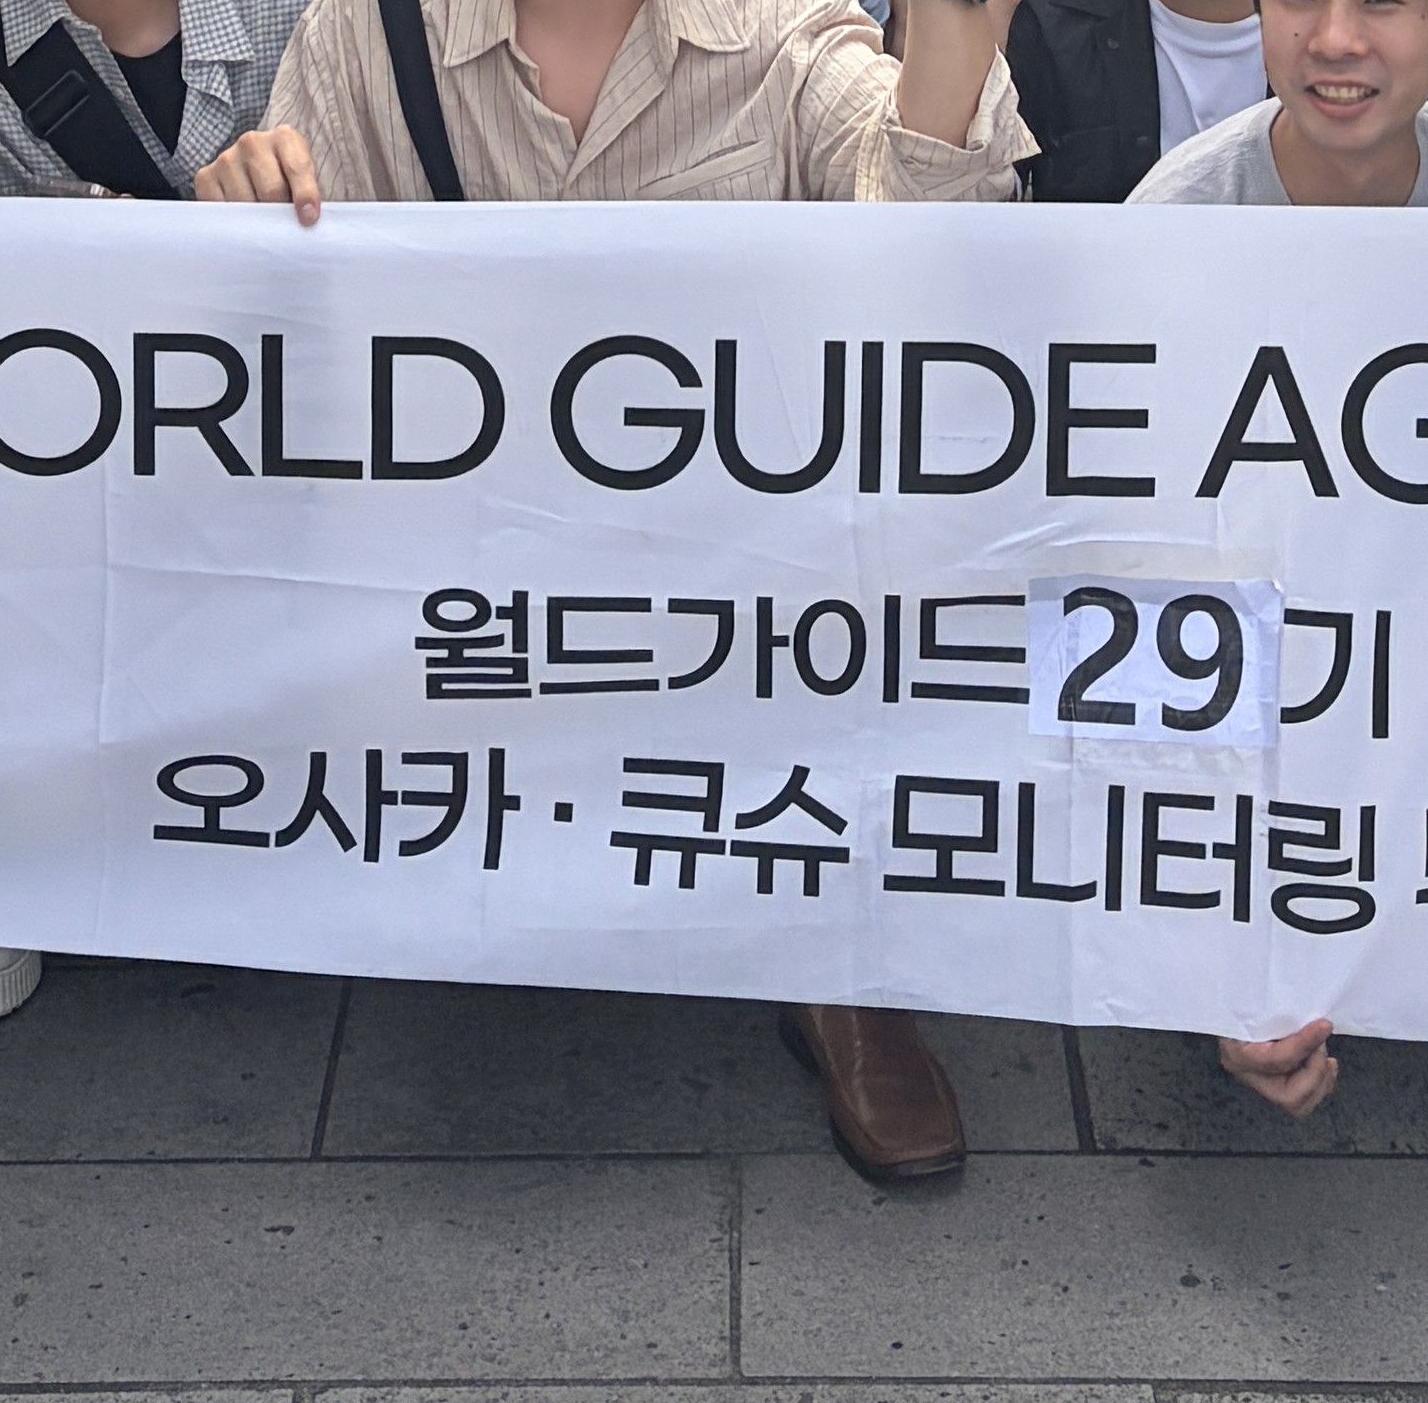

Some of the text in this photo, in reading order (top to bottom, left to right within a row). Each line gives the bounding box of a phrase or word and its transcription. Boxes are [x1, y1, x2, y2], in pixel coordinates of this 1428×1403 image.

[550, 335, 1157, 498] GUIDE
[414, 586, 1391, 739] 월드가이드29기
[882, 774, 1377, 935] 모니터링
